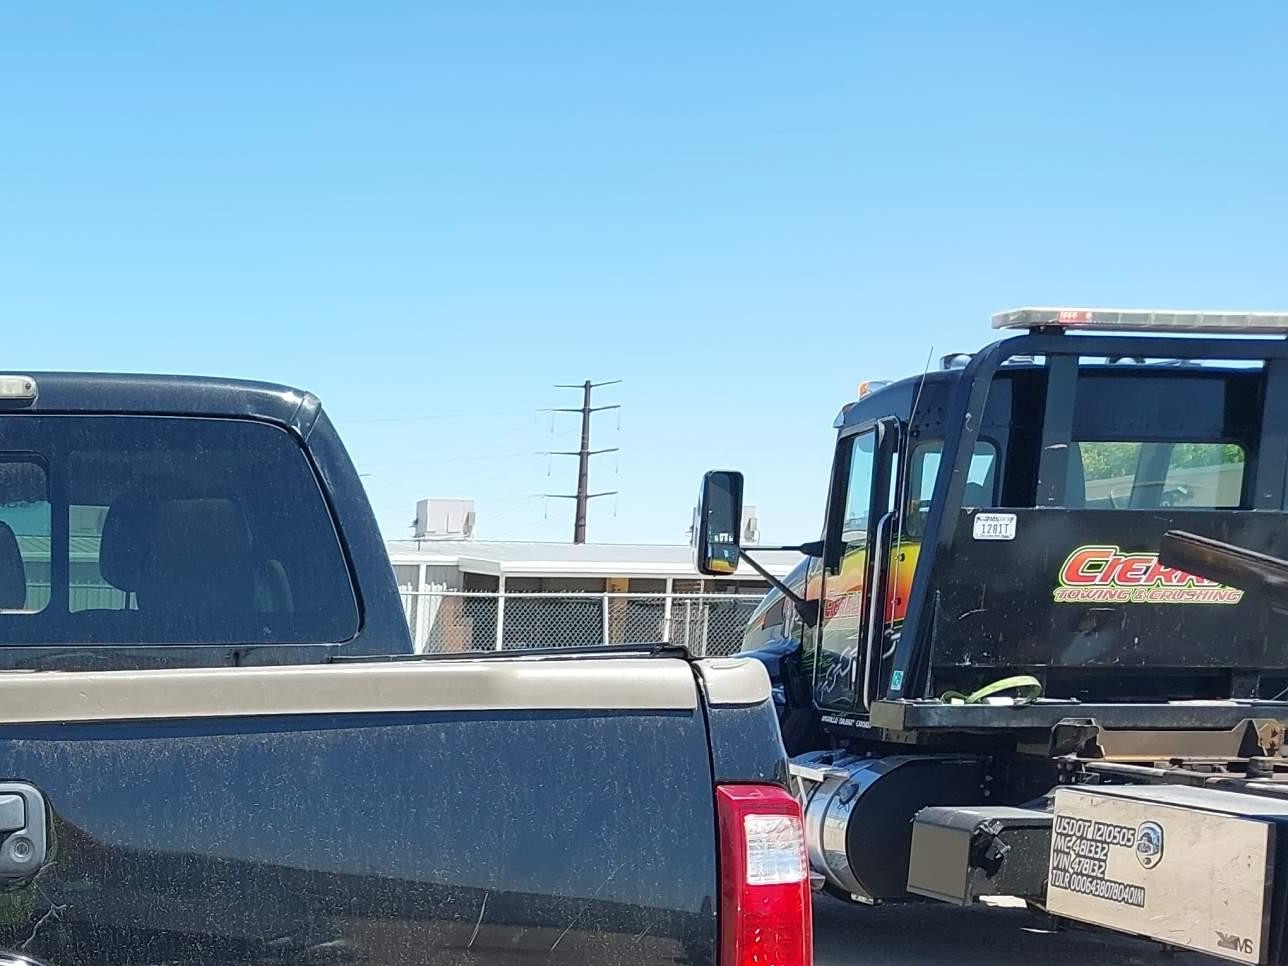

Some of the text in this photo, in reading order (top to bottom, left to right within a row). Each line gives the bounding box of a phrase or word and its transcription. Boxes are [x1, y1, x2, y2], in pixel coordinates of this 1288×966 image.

[1055, 588, 1241, 602] TOWING & CRUSHING
[1055, 816, 1135, 846] USDOT 1210505
[1054, 834, 1109, 860] MC 481332
[1053, 851, 1106, 878] VIN 478132
[1052, 869, 1070, 888] TDLR
